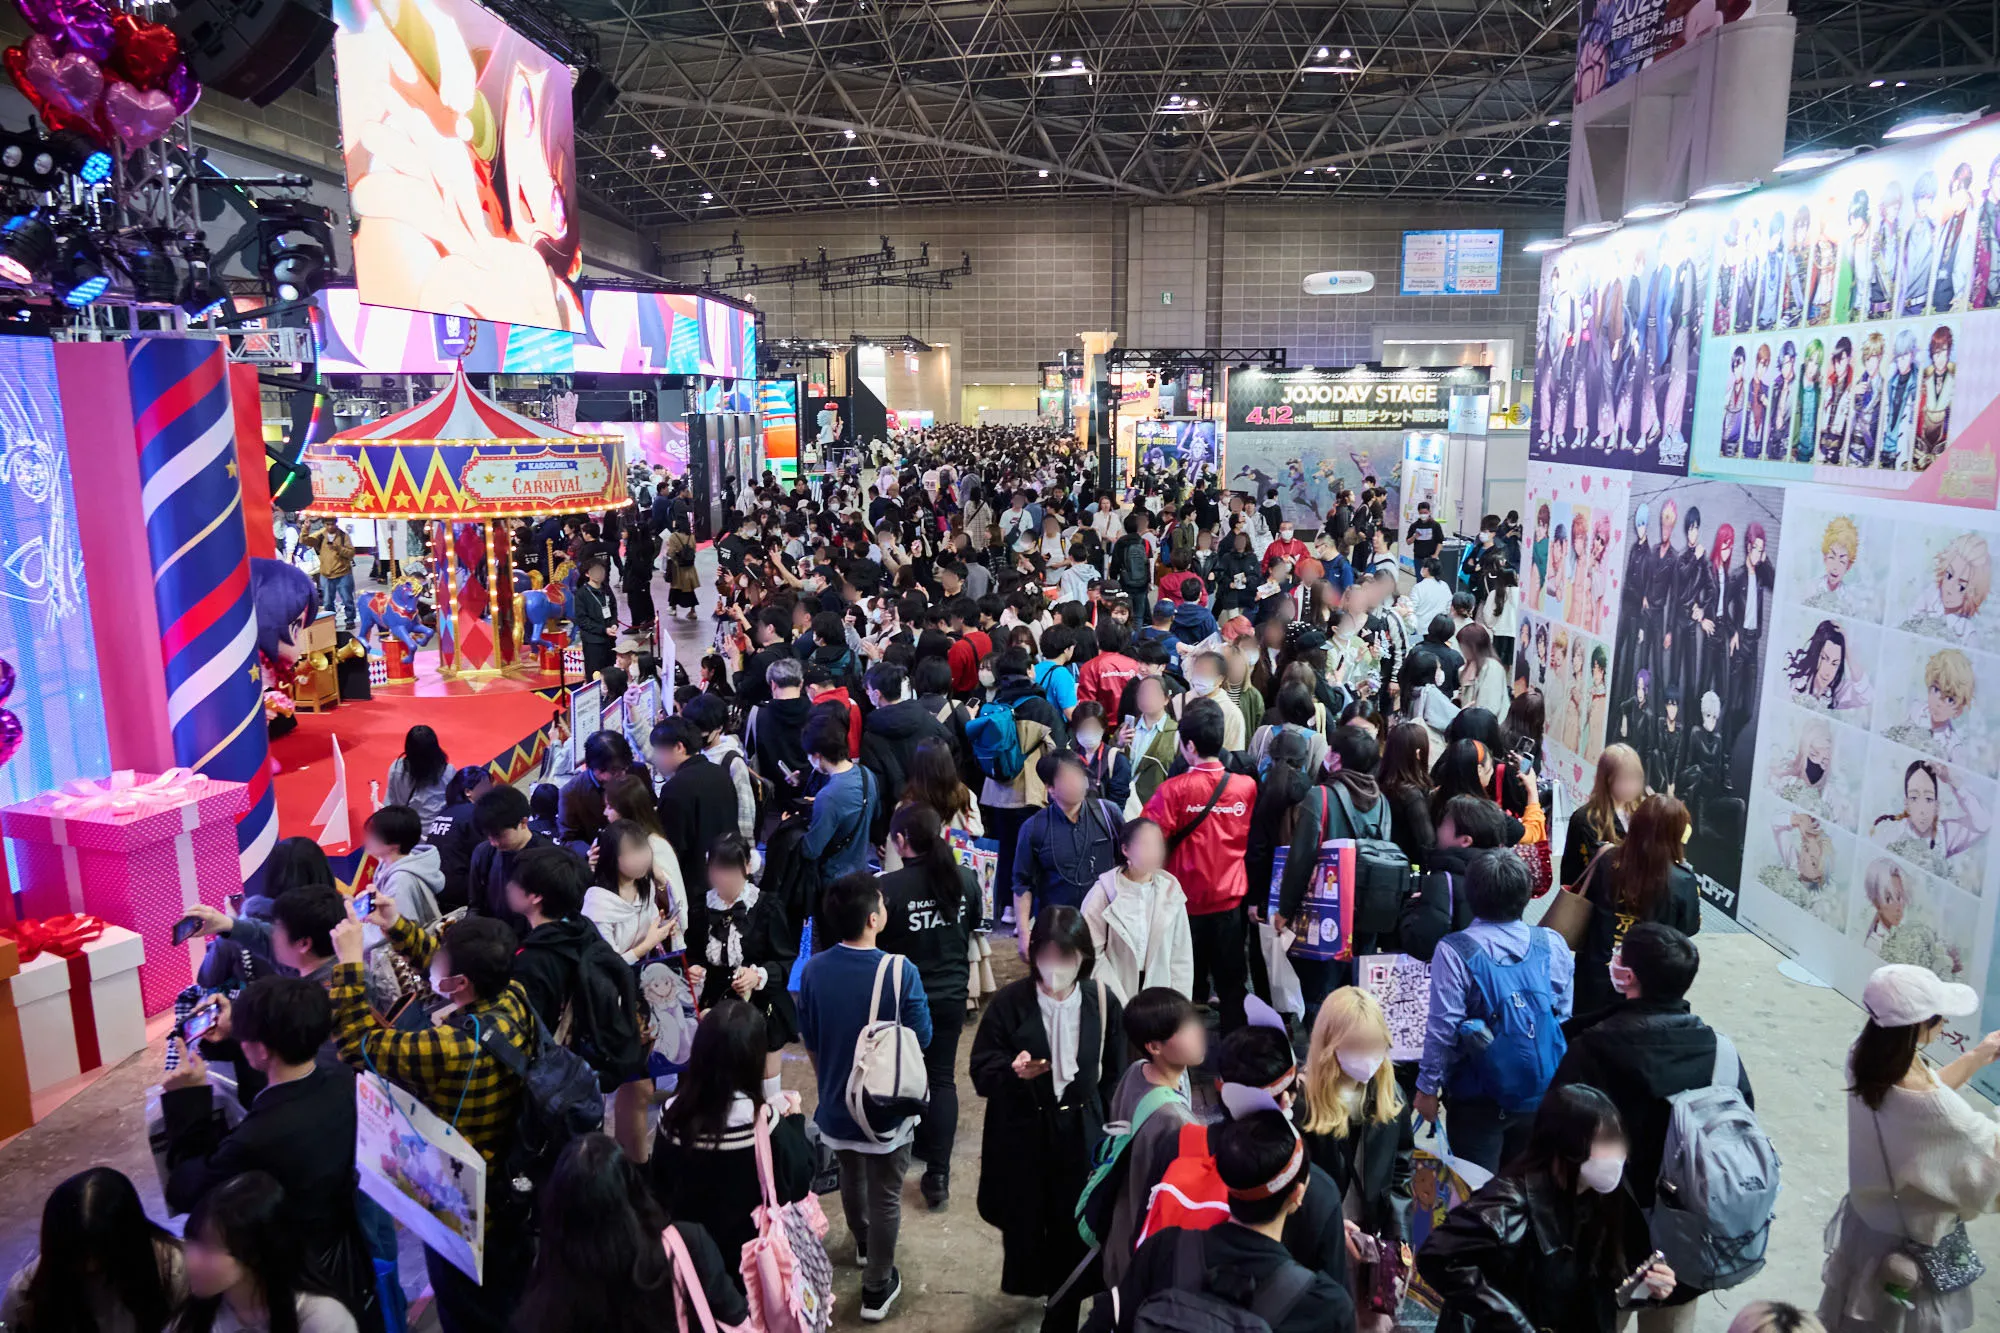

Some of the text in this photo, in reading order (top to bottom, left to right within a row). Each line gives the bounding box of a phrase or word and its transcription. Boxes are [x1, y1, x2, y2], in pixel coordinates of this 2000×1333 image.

[1375, 384, 1438, 403] STAGE
[528, 461, 569, 470] KADOKAWA
[512, 475, 582, 495] CARNIVAL
[1186, 804, 1234, 814] Animapan
[430, 822, 452, 836] AFF
[917, 895, 967, 909] KADA
[908, 905, 966, 932] STAF
